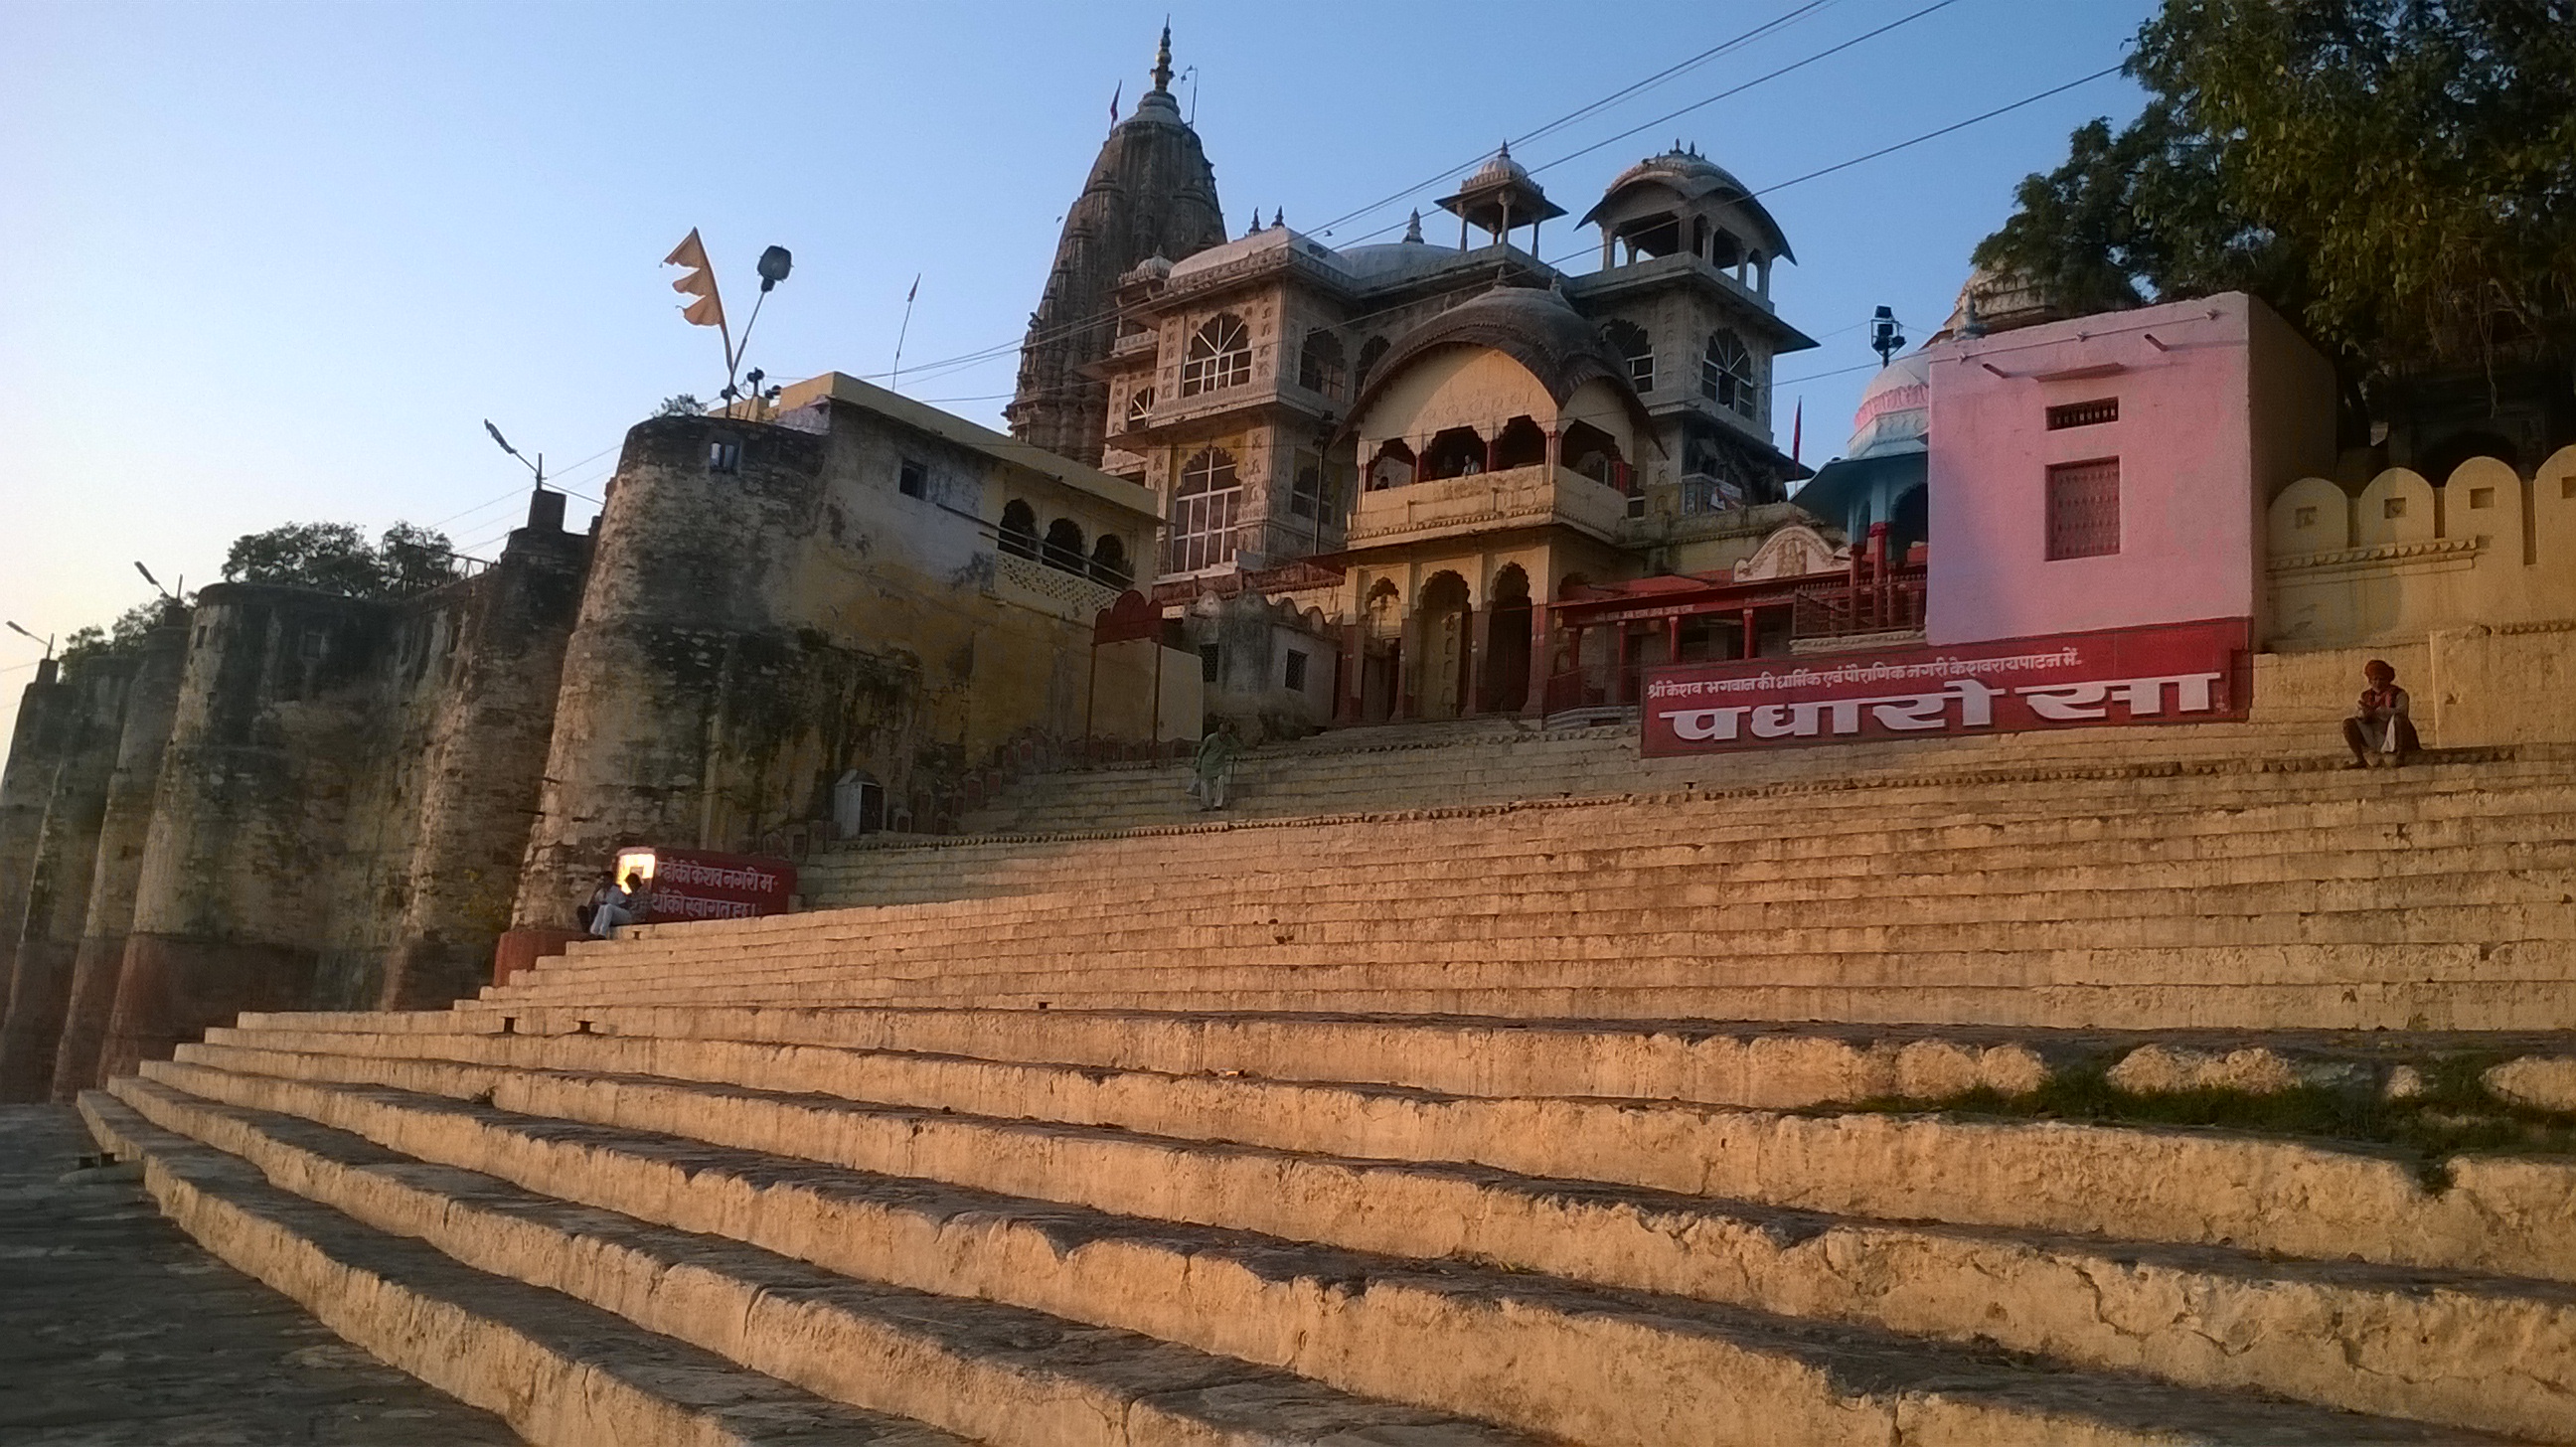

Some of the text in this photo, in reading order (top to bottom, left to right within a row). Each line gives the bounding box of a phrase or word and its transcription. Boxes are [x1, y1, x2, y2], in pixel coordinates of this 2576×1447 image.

[1705, 677, 1755, 695] भगवान
[1756, 671, 1774, 691] की
[1775, 668, 1821, 690] धार्मिक
[1907, 656, 1948, 680] नगरी
[1659, 672, 2221, 741] पधारो सा
[723, 866, 759, 891] नगरी
